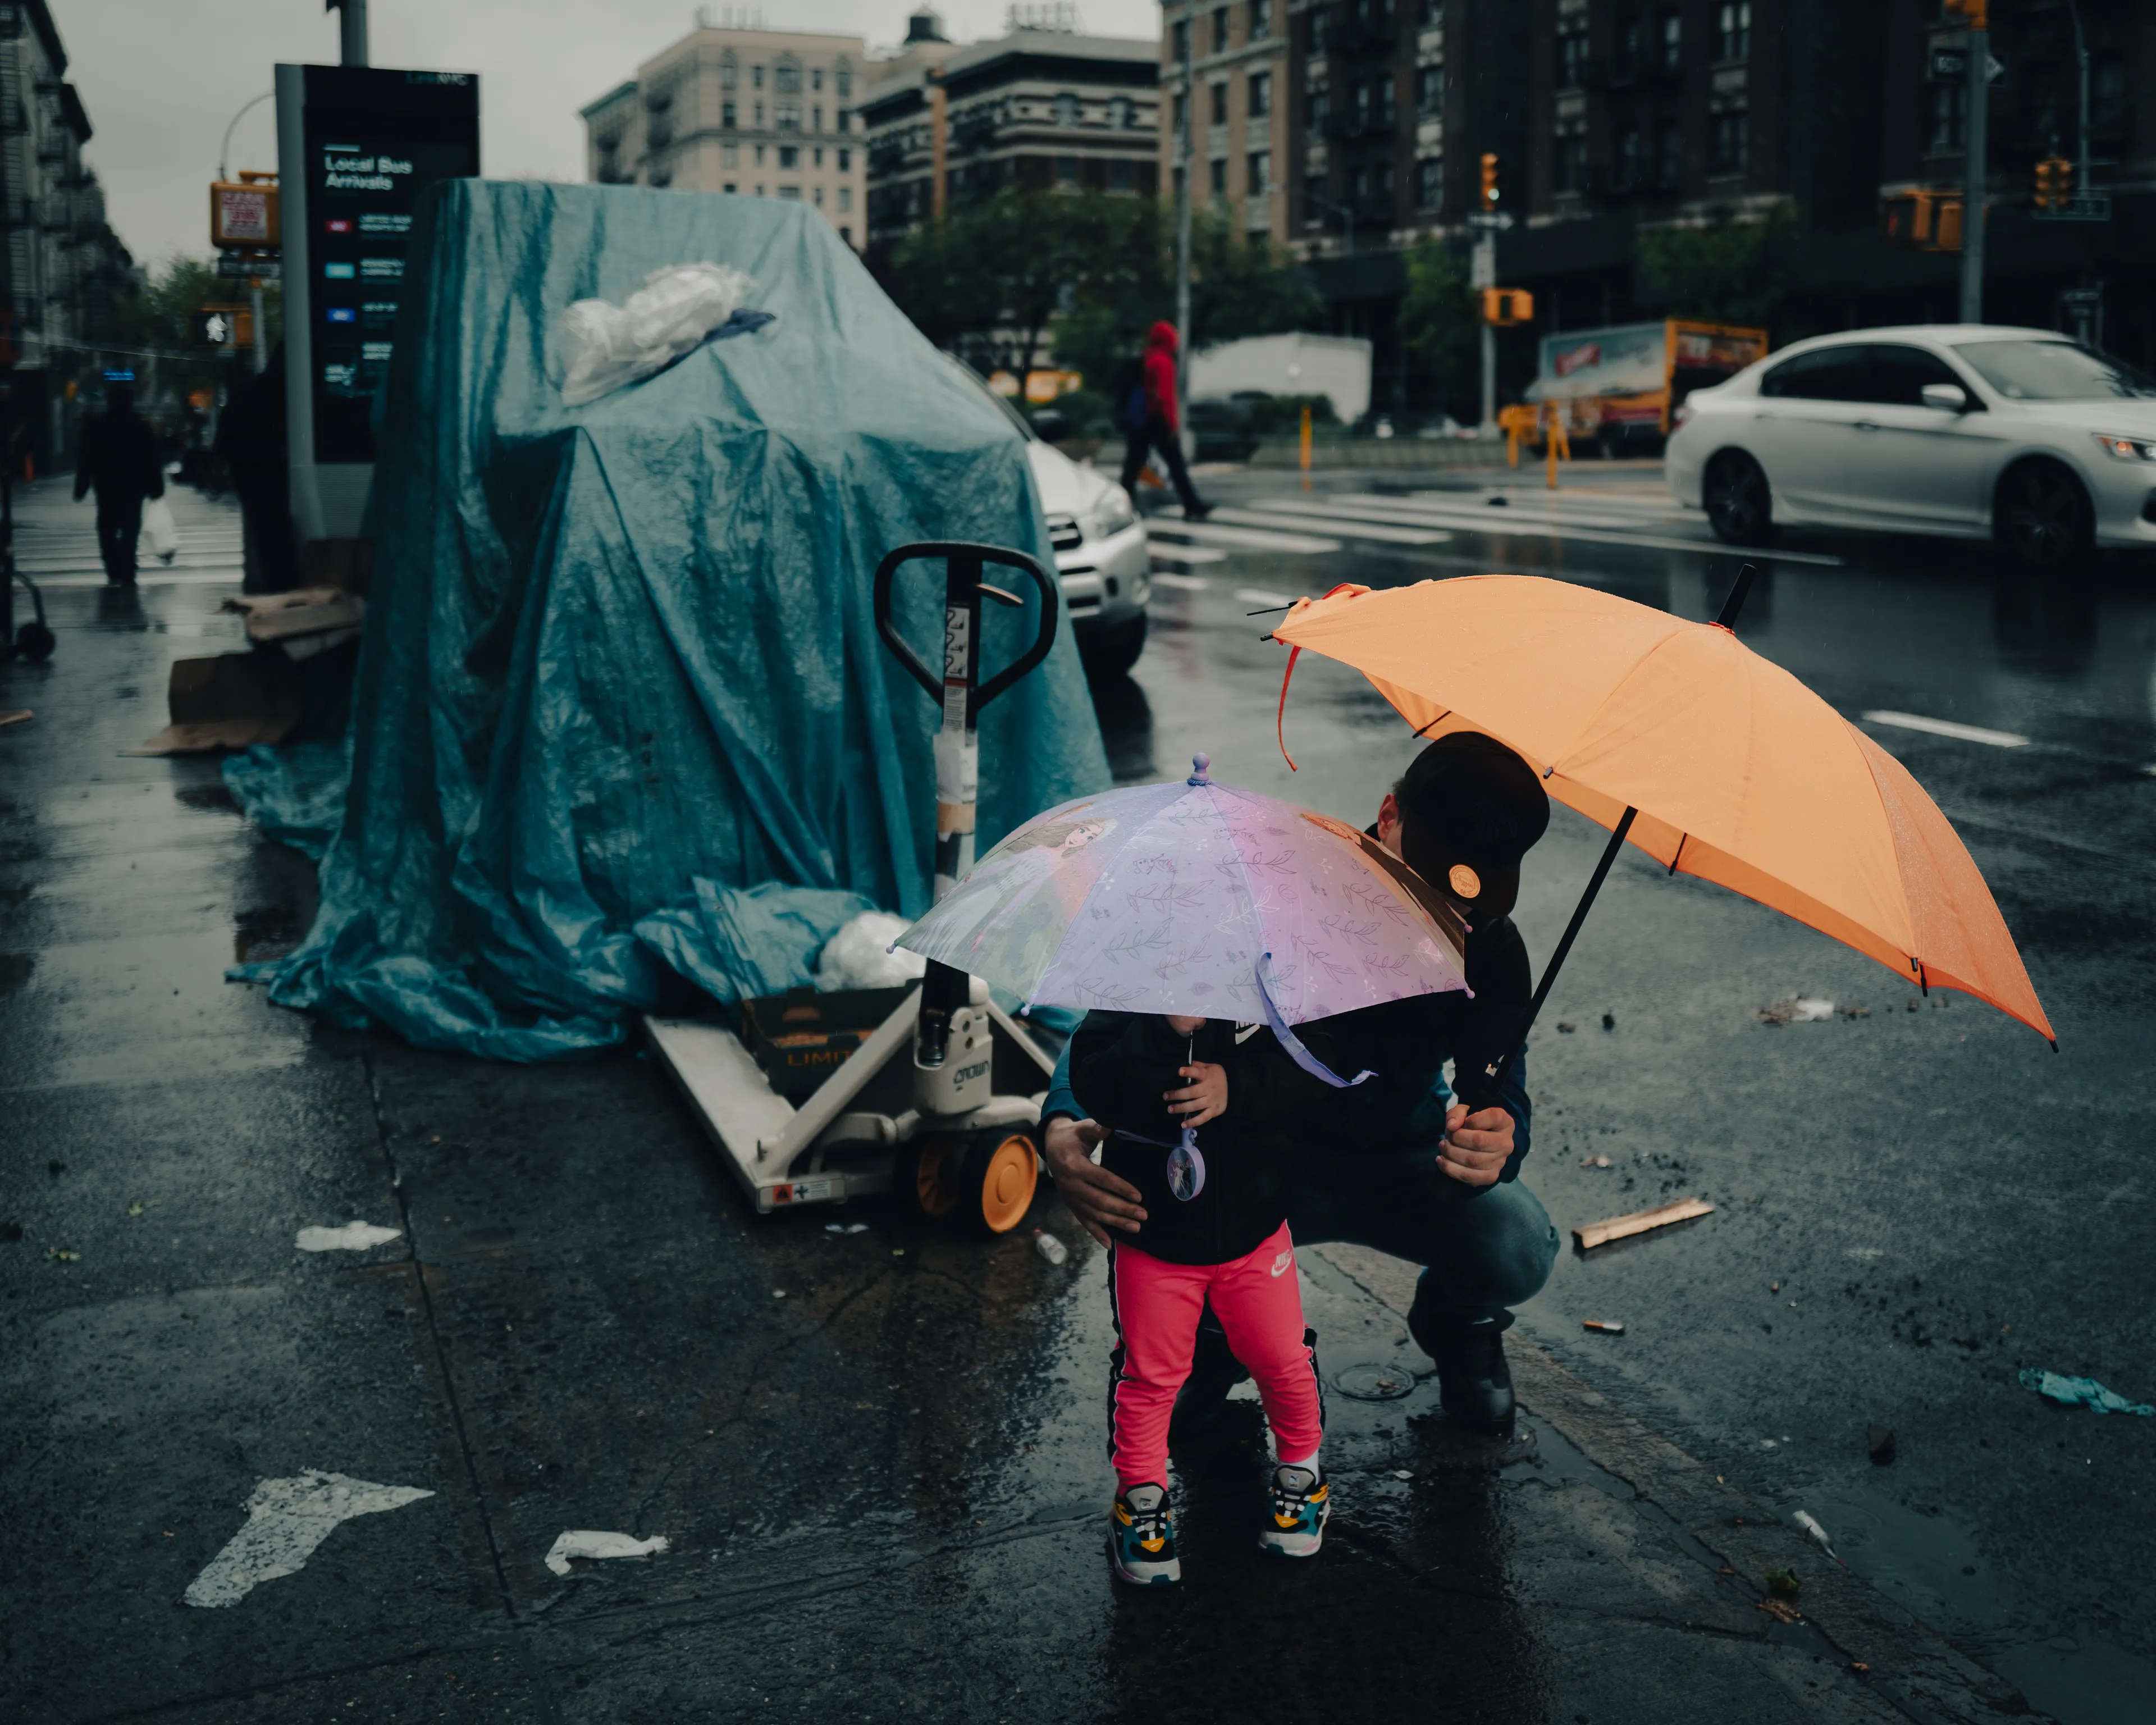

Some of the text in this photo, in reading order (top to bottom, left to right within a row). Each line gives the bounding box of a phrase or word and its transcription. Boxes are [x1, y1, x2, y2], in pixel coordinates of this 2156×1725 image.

[324, 153, 413, 174] Local Bus
[325, 172, 393, 190] Arrivals
[1276, 1249, 1290, 1267] NIKE
